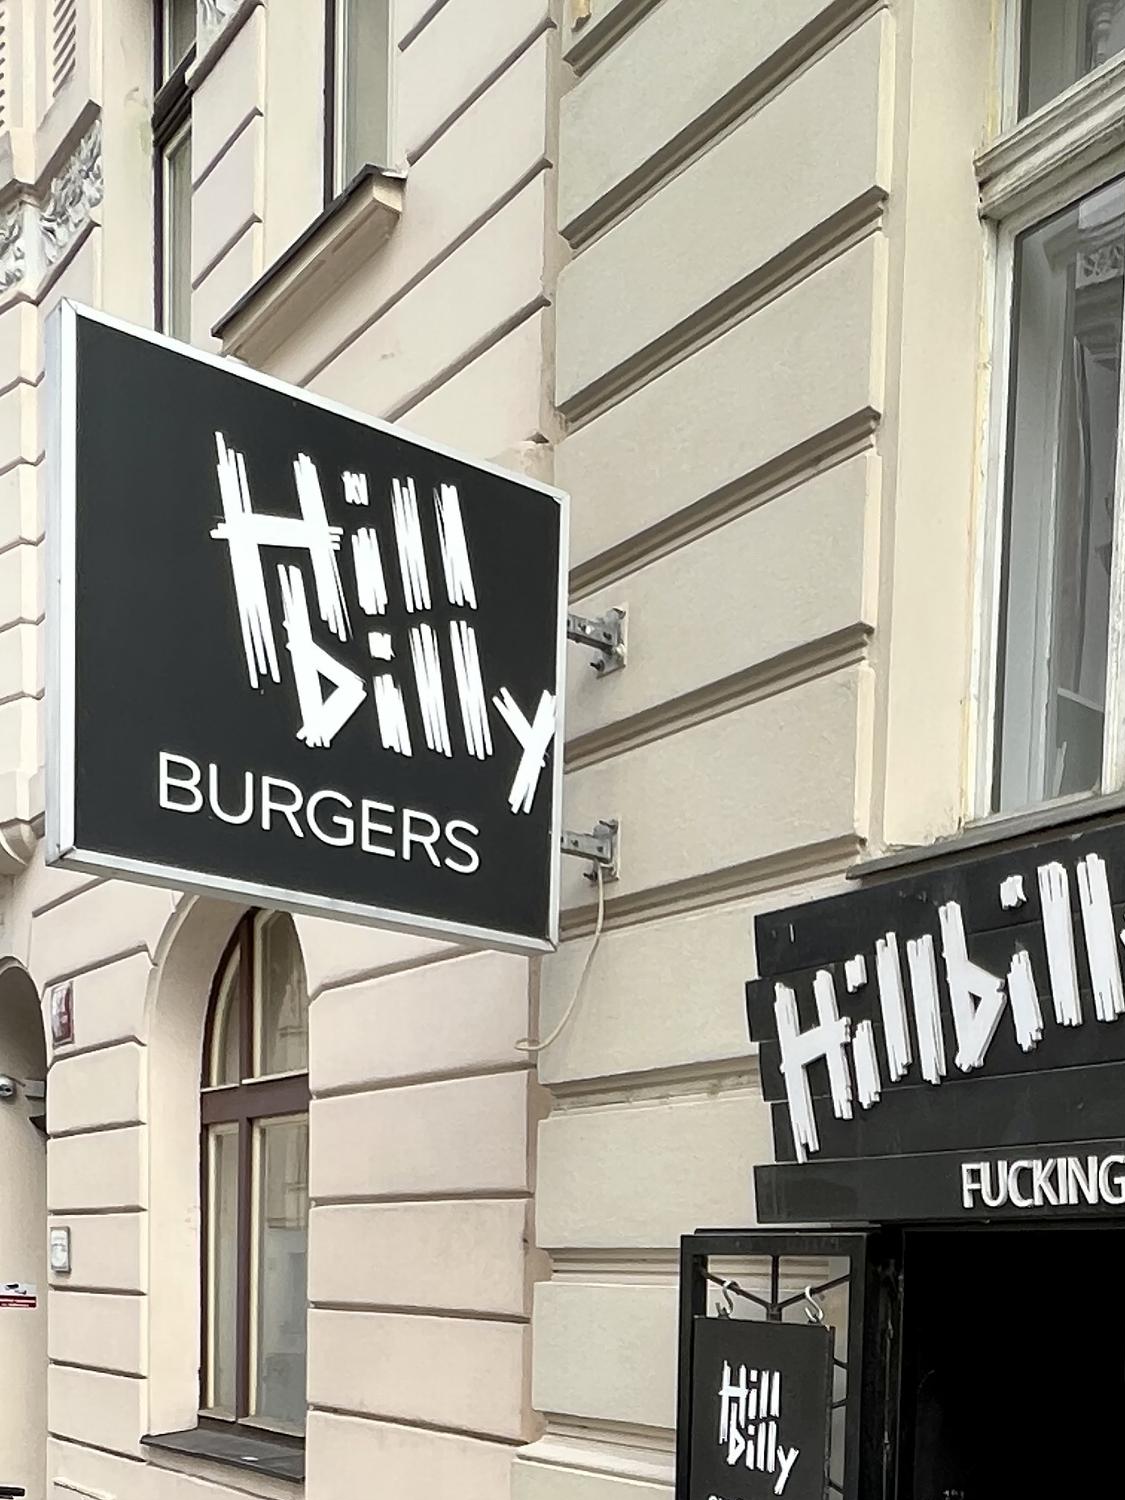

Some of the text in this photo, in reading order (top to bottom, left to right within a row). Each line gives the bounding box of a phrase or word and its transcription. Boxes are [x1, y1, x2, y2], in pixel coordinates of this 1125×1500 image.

[210, 431, 478, 689] Hill
[276, 562, 557, 815] billy
[158, 751, 481, 875] BURGERS
[718, 1360, 780, 1445] Hill
[726, 1401, 799, 1495] billy
